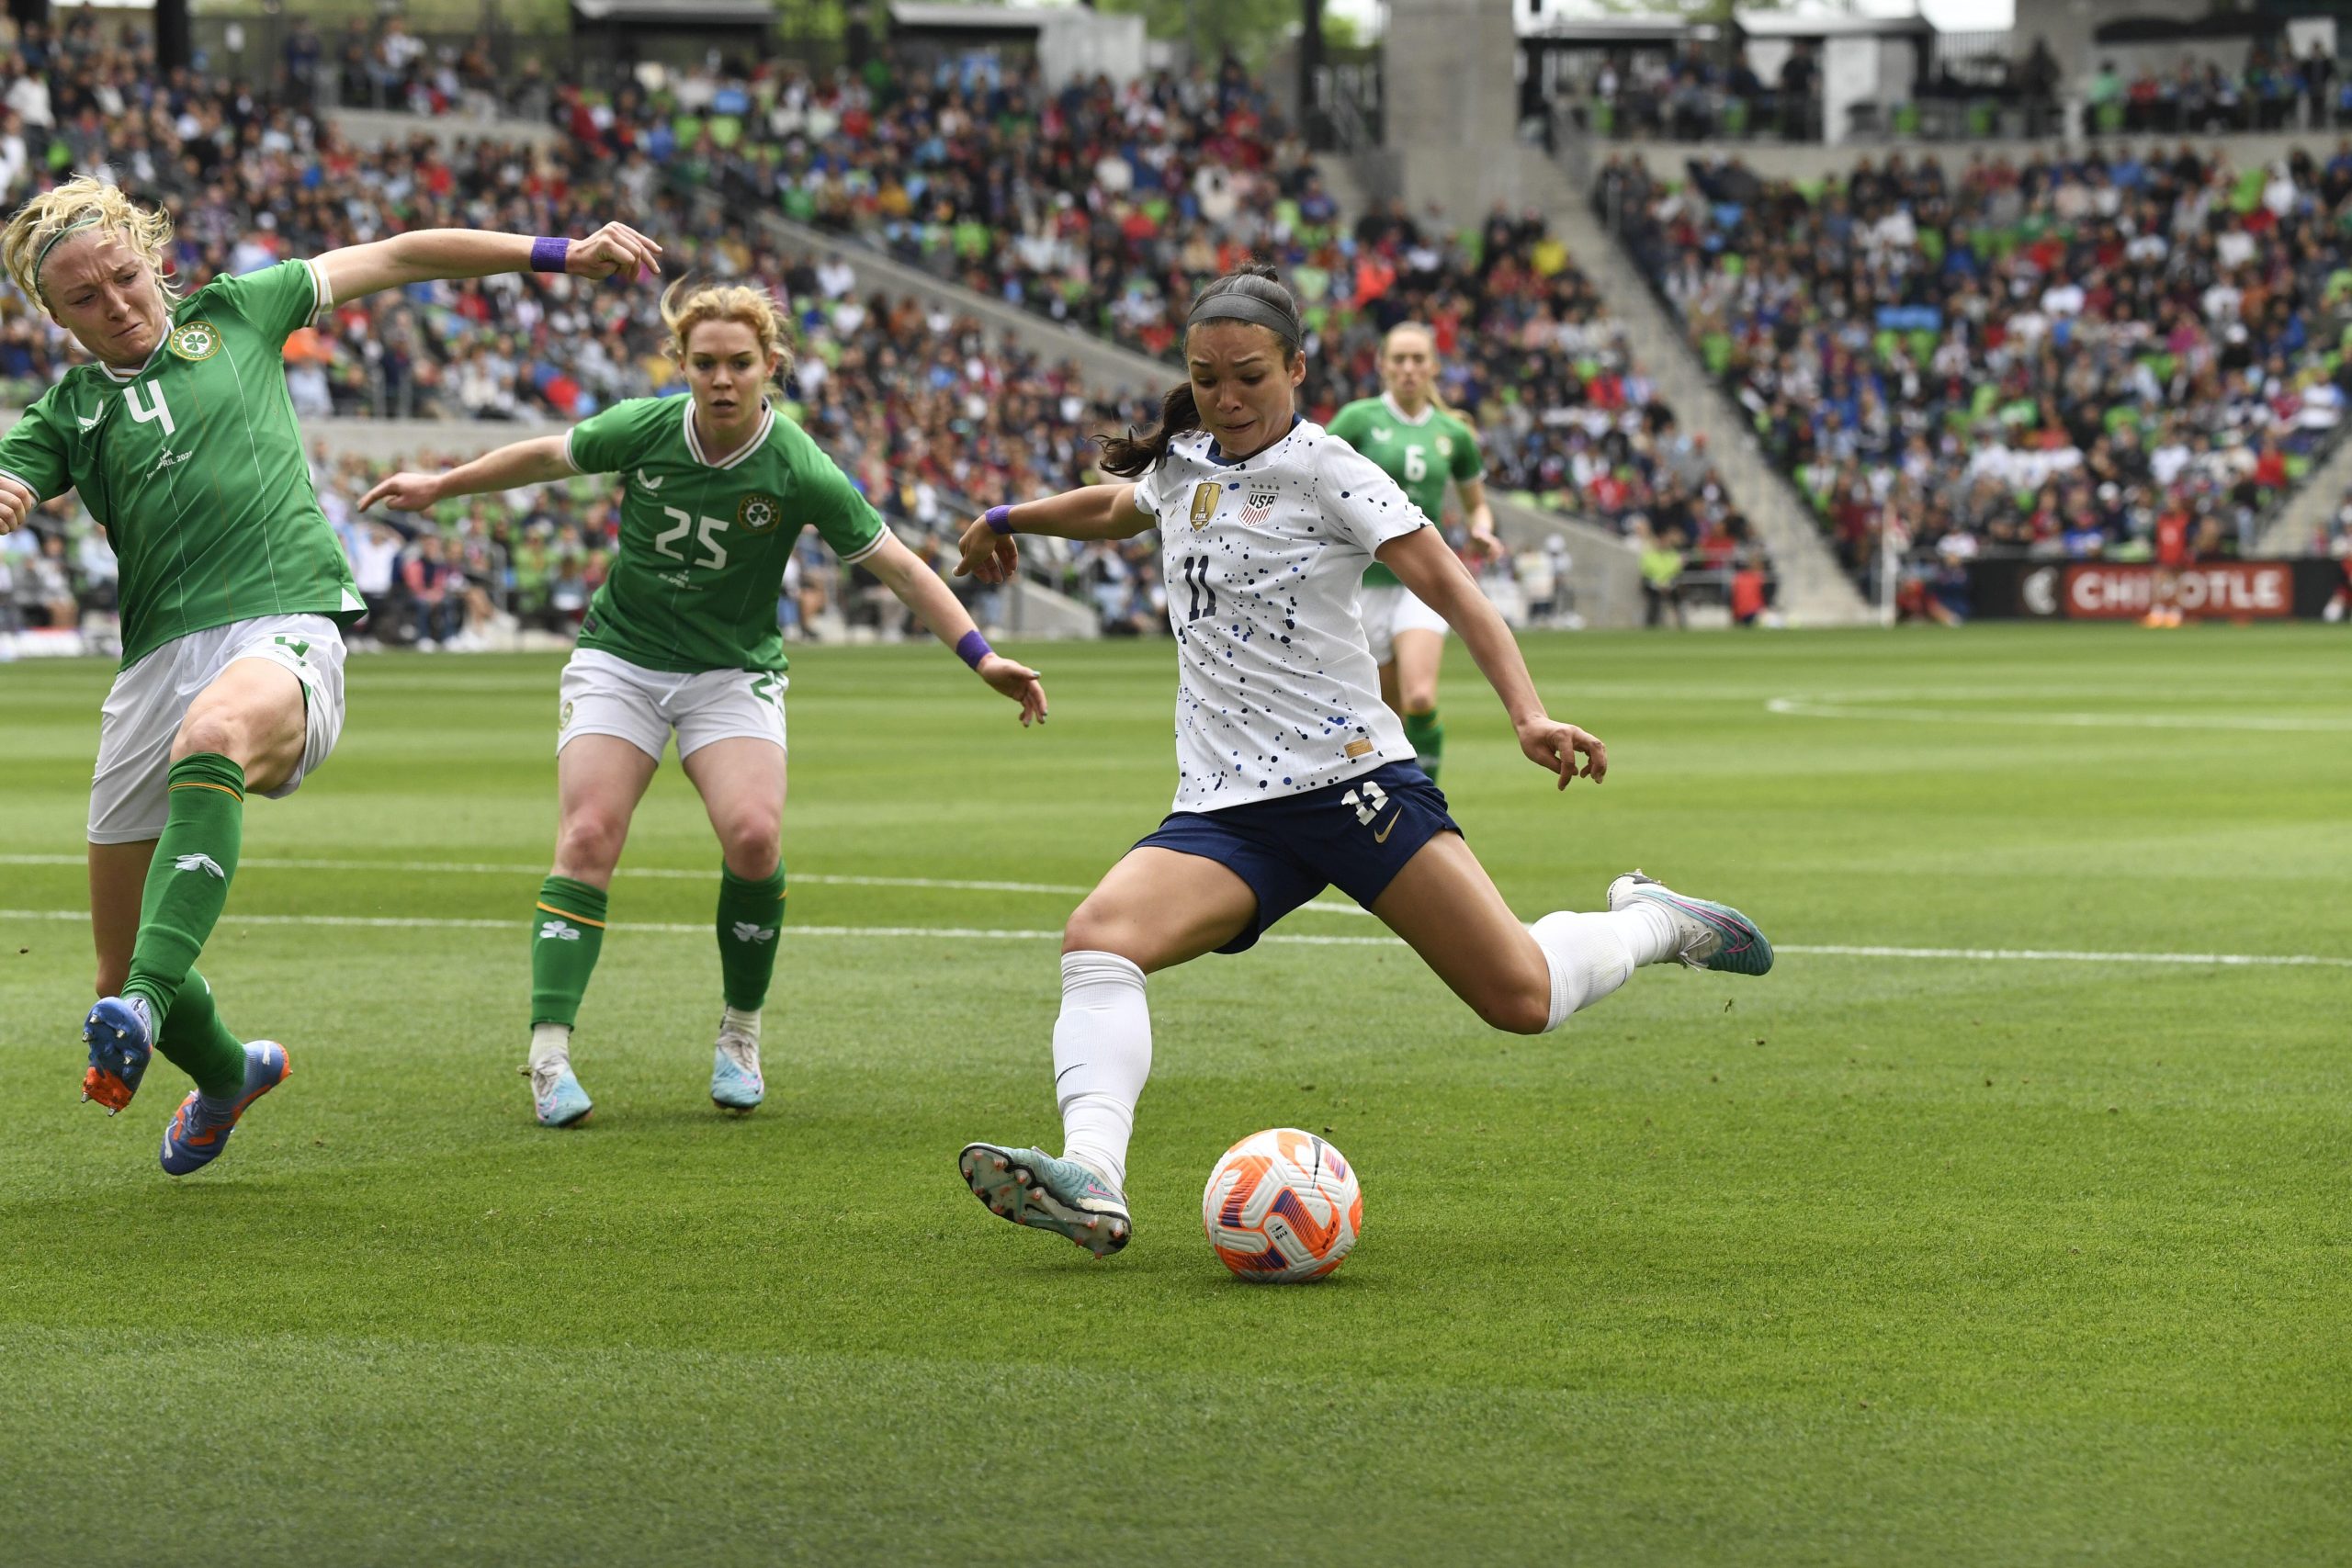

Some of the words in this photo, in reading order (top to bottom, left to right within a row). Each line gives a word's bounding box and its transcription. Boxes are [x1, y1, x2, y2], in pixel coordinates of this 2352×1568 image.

[173, 324, 210, 344] IRELAND
[123, 379, 175, 436] 4
[1404, 445, 1427, 482] 6
[1249, 494, 1276, 509] USA
[654, 505, 730, 570] 25
[1183, 555, 1217, 623] 11
